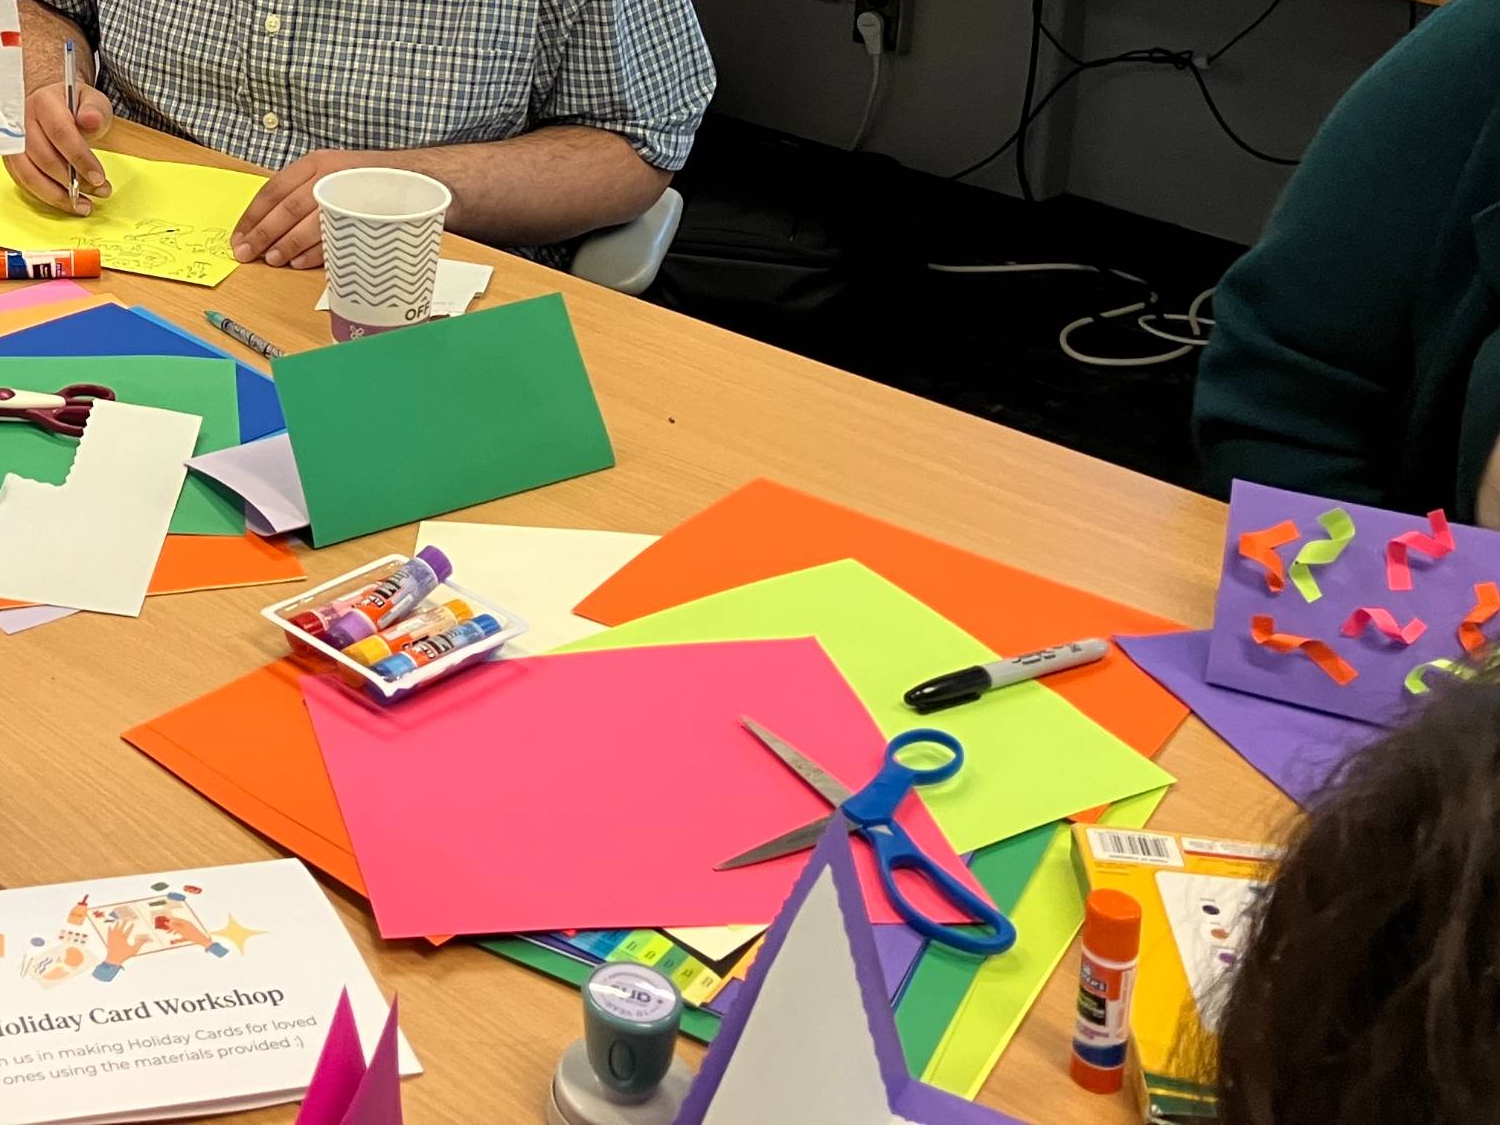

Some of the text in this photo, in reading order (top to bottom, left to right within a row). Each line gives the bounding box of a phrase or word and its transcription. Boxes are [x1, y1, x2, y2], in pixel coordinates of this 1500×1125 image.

[88, 1001, 152, 1025] Card
[153, 988, 285, 1016] Workshop
[3, 1071, 46, 1085] ones
[49, 1062, 98, 1078] using
[100, 1059, 130, 1072] the
[134, 1047, 214, 1068] materials
[216, 1036, 291, 1060] provided
[13, 1053, 34, 1065] us
[37, 1049, 54, 1062] in
[58, 1041, 124, 1060] making
[127, 1033, 190, 1051] Holiday
[194, 1025, 244, 1041] Cards
[245, 1021, 268, 1035] for
[271, 1014, 318, 1031] loved
